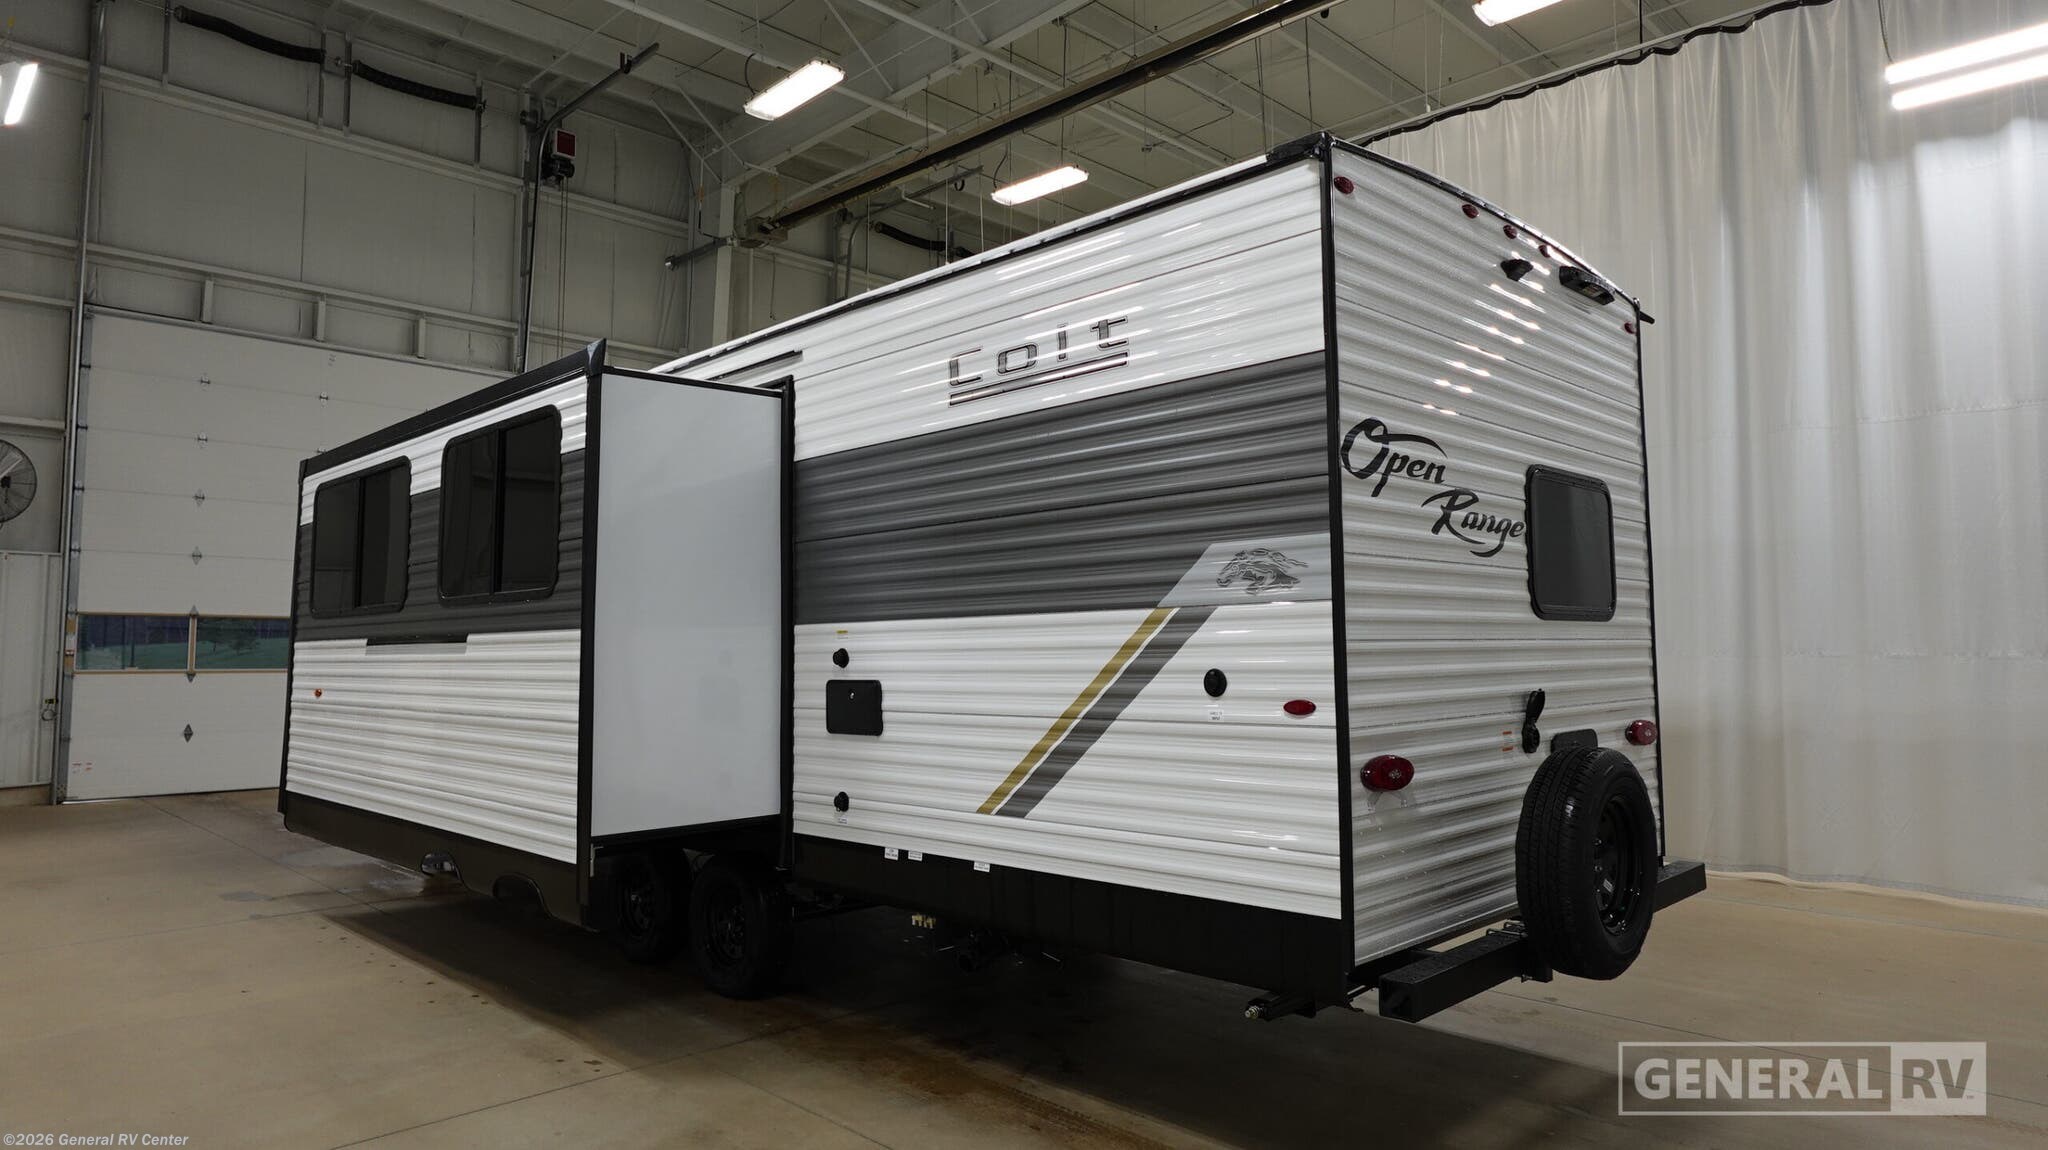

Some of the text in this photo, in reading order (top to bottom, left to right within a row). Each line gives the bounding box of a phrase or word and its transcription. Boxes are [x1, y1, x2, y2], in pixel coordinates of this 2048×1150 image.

[948, 316, 1129, 387] Colt
[1340, 417, 1448, 498] Open
[1421, 487, 1525, 558] Range
